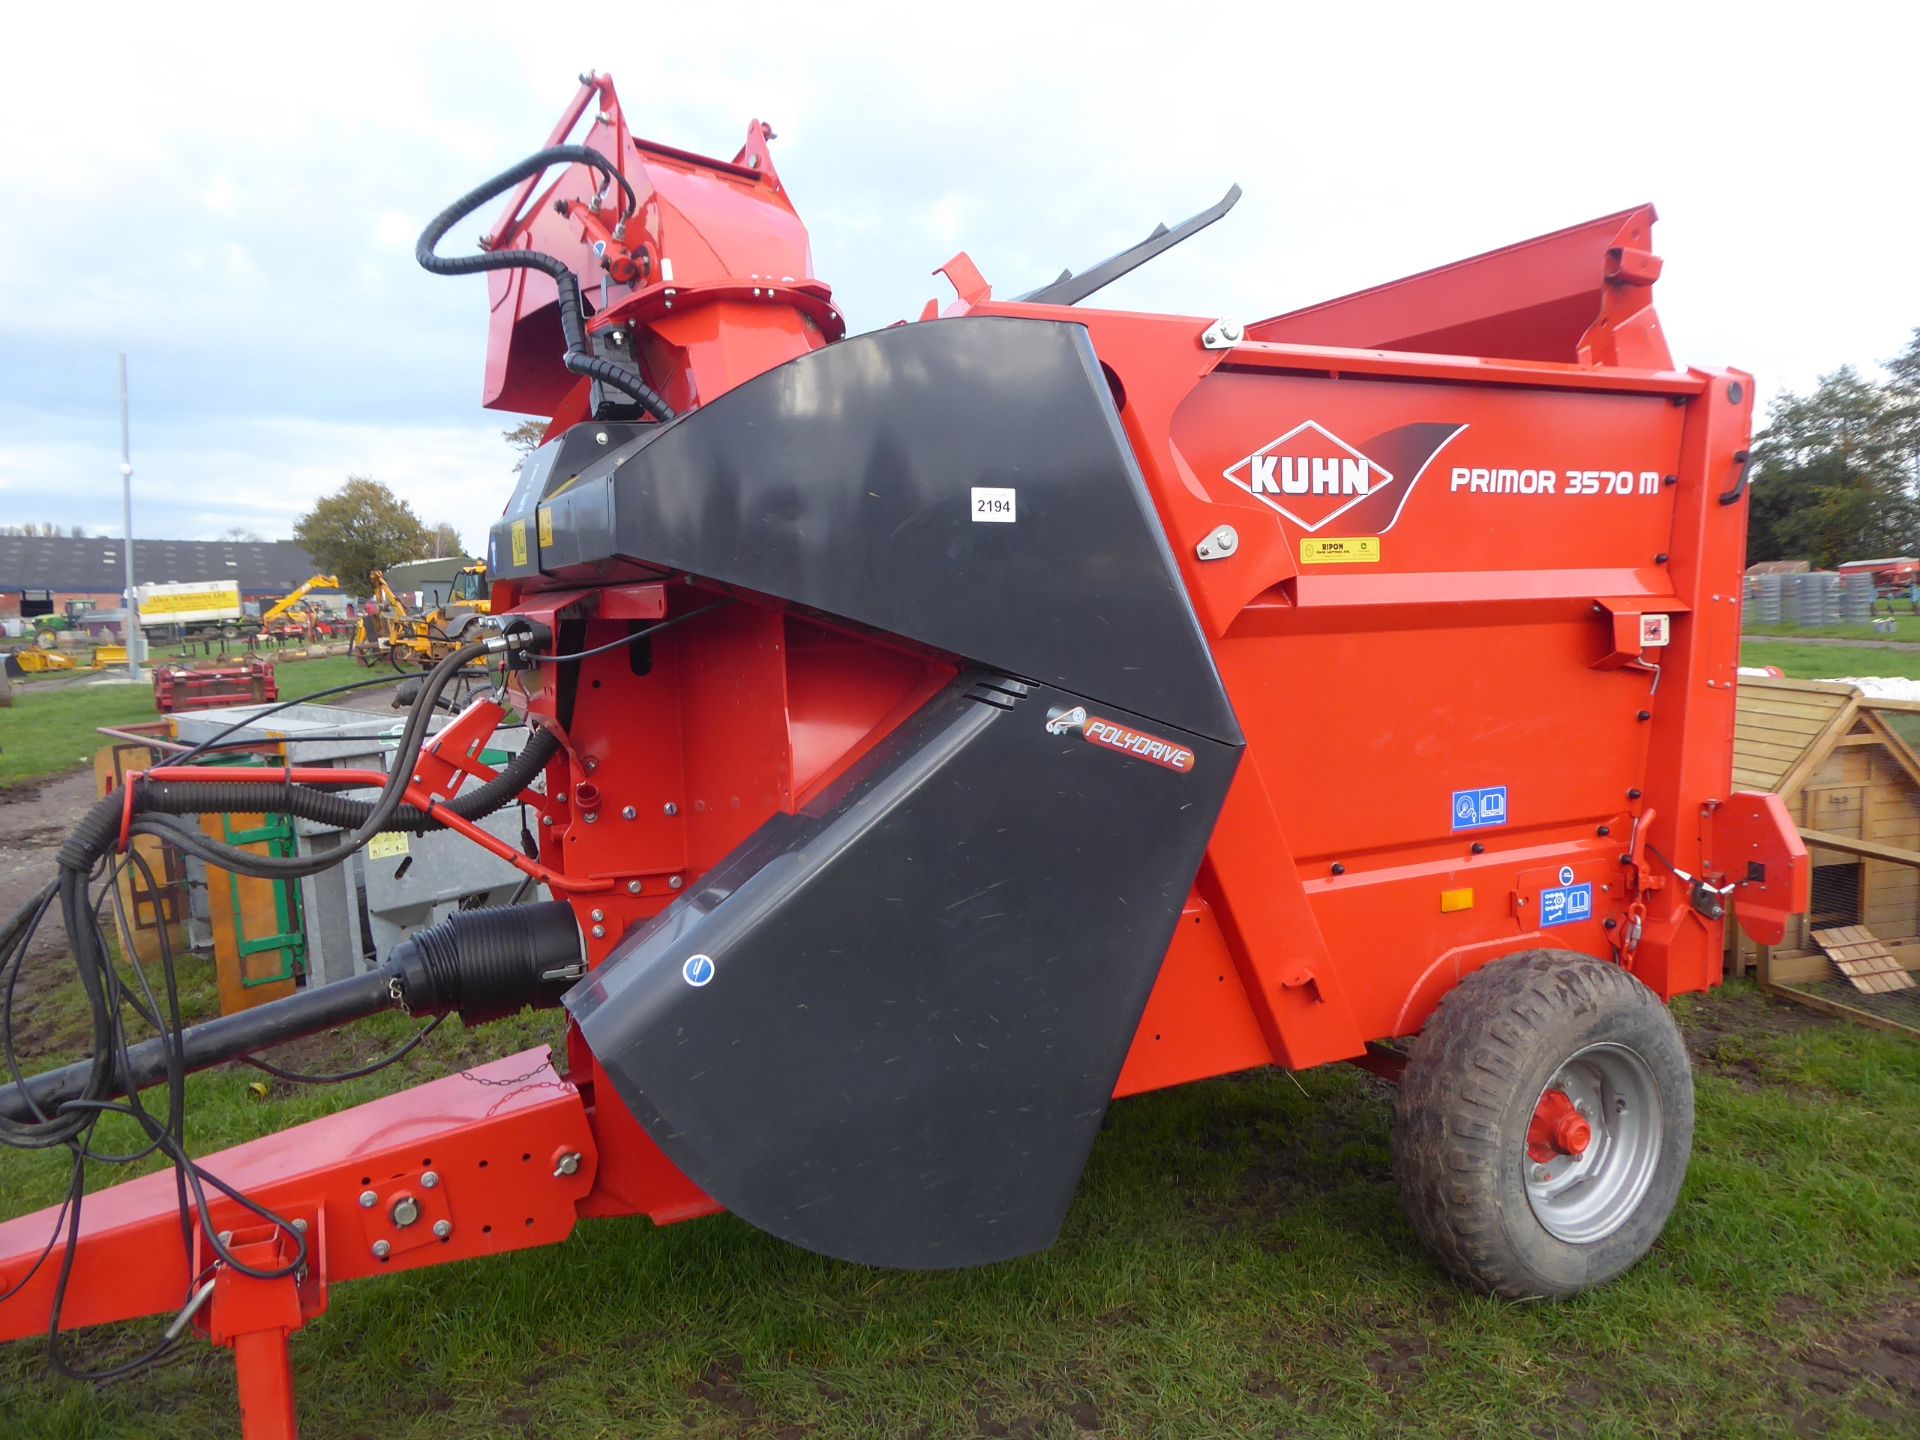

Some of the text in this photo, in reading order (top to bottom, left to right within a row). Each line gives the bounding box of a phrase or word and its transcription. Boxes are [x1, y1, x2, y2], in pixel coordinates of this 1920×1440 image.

[1251, 455, 1369, 495] KUHN
[1451, 467, 1557, 494] PRIMOR
[1564, 470, 1634, 495] 3570
[977, 499, 1010, 513] 2194
[1322, 543, 1344, 551] RIPON
[1085, 721, 1191, 768] POLYDRIVE
